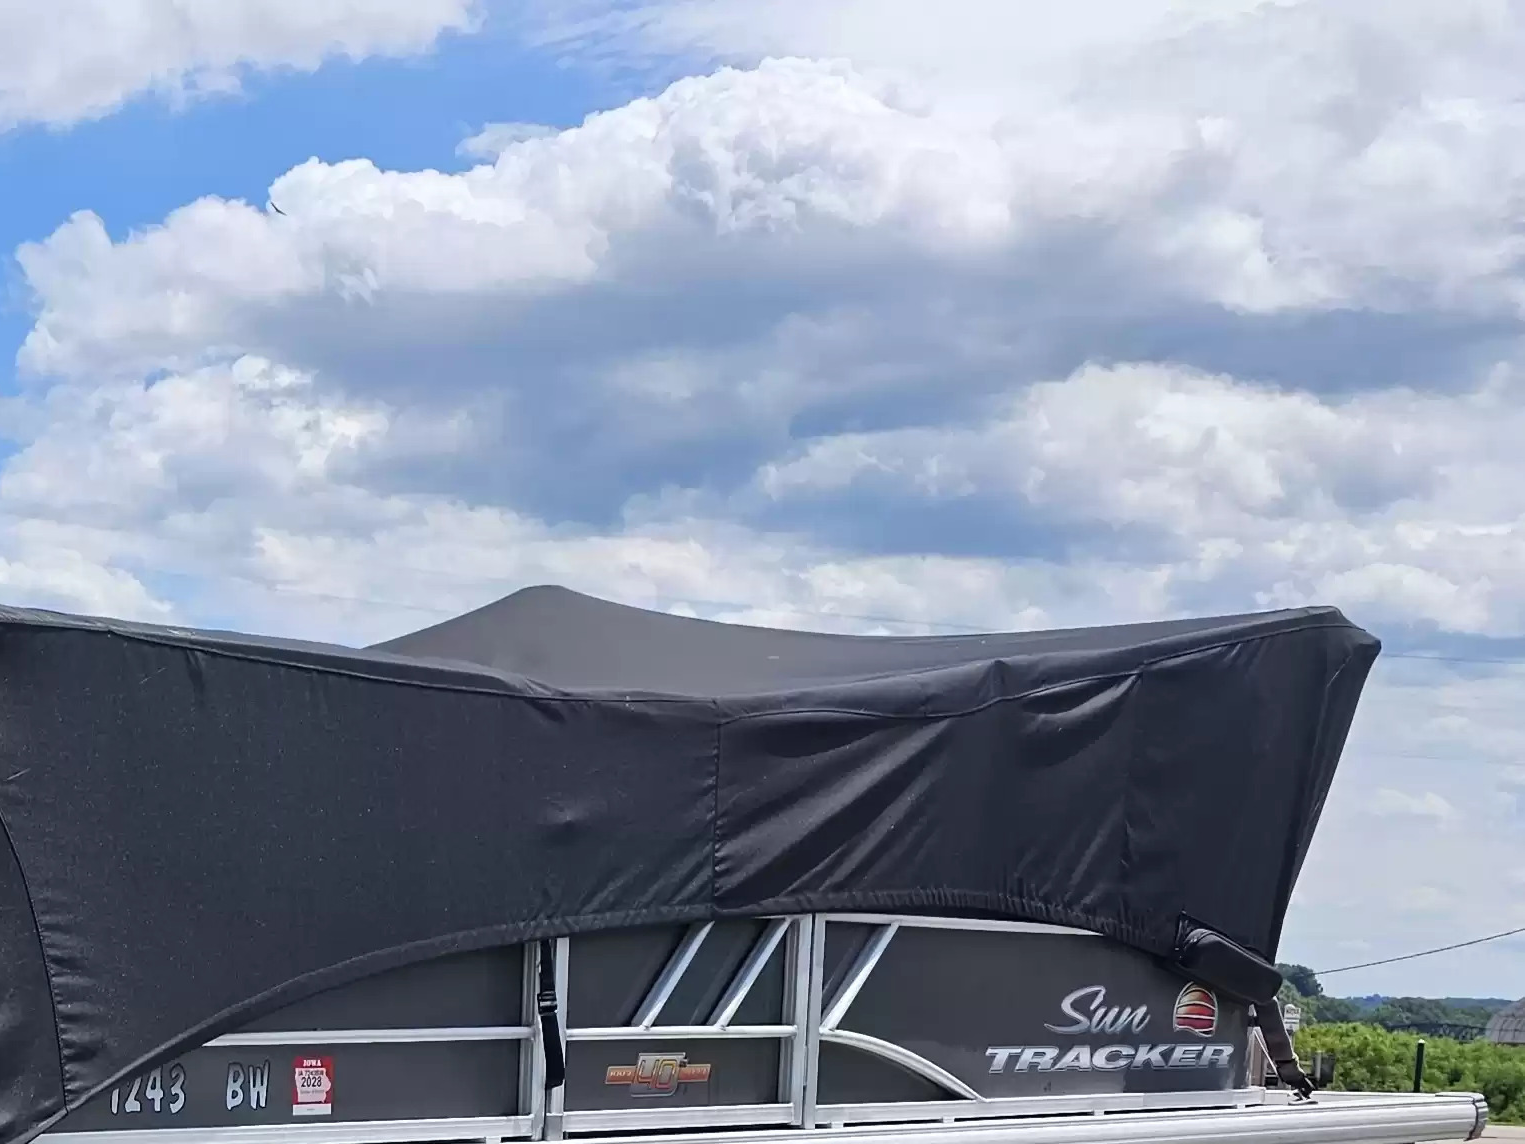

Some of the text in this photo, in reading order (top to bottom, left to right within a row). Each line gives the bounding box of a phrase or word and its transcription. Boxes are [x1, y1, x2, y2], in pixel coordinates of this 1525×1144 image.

[1043, 984, 1151, 1035] Sun
[302, 1059, 322, 1067] IOWA
[985, 1043, 1235, 1074] TRACKER
[225, 1060, 271, 1111] BW
